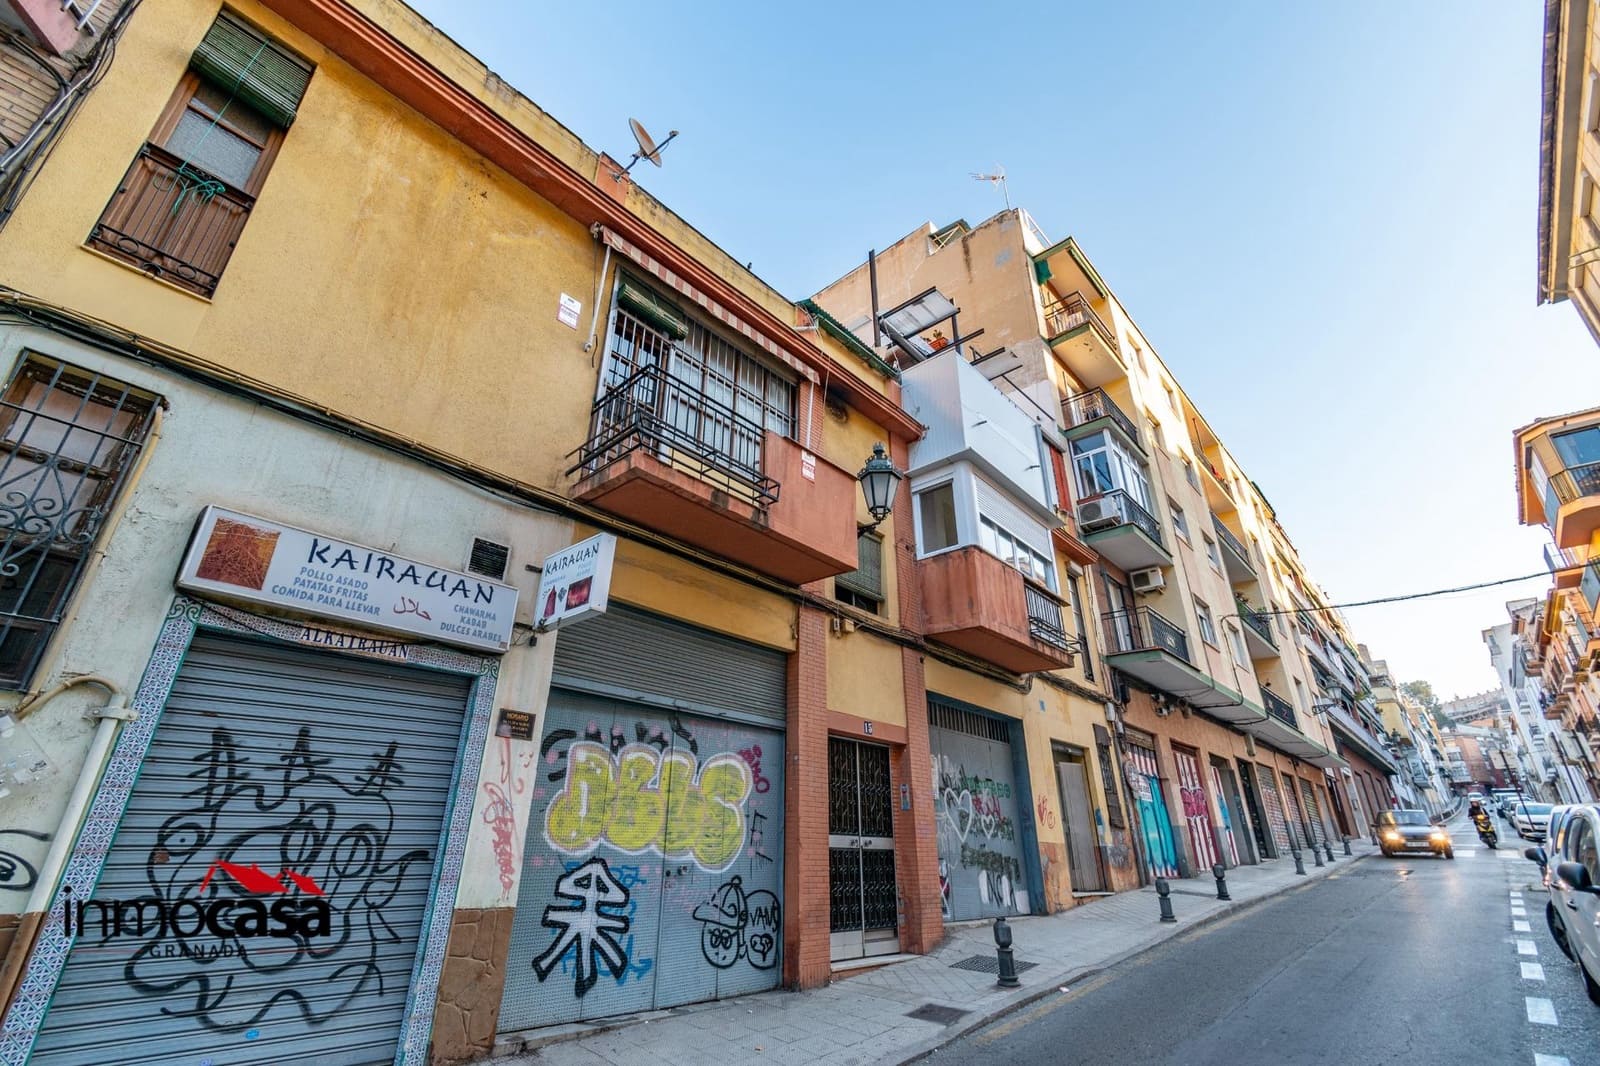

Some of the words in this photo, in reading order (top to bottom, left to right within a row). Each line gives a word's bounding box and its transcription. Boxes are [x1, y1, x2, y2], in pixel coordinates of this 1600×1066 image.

[308, 538, 494, 604] KAIRAUAN
[545, 542, 600, 576] KAIRAUAN
[294, 577, 334, 594] PATATAS
[336, 586, 369, 602] FRITAS
[300, 566, 333, 582] POLLO
[335, 575, 368, 590] ASADO
[272, 584, 314, 601] COMIDA
[317, 594, 342, 608] PARA
[345, 601, 380, 616] LLEVAR
[393, 596, 432, 621] حلال
[454, 604, 496, 621] CHAWARMA
[440, 622, 470, 635] DULCES
